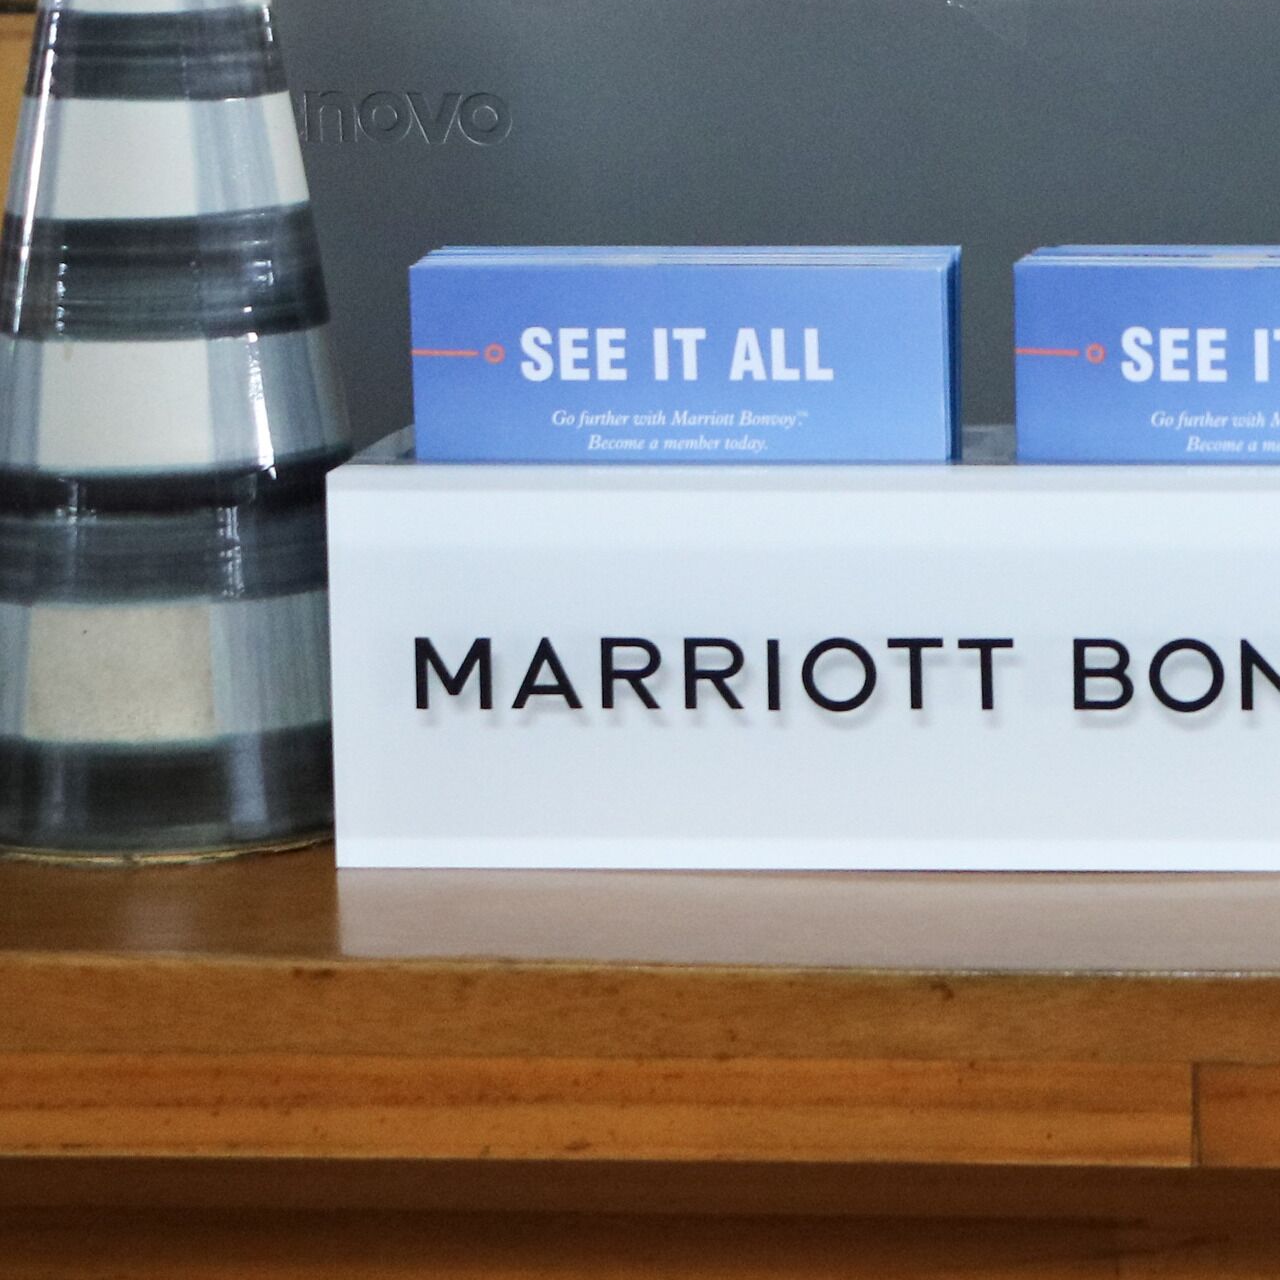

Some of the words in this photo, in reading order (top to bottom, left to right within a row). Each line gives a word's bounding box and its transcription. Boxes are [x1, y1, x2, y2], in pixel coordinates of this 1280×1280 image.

[299, 90, 513, 146] novo
[520, 326, 627, 382] SEE
[653, 327, 706, 381] IT
[728, 327, 834, 381] ALL
[1121, 326, 1228, 382] SEE
[552, 410, 575, 426] Go
[577, 410, 629, 429] further
[633, 411, 666, 426] with
[671, 410, 735, 426] Marriott
[1150, 411, 1174, 427] Go
[1175, 411, 1228, 430] further
[1232, 412, 1266, 427] with
[587, 434, 644, 450] Become
[649, 439, 659, 450] a
[663, 435, 721, 450] member
[724, 435, 769, 454] today.
[1186, 436, 1243, 452] Become
[1248, 441, 1257, 452] a
[414, 637, 1014, 713] MARRIOTT
